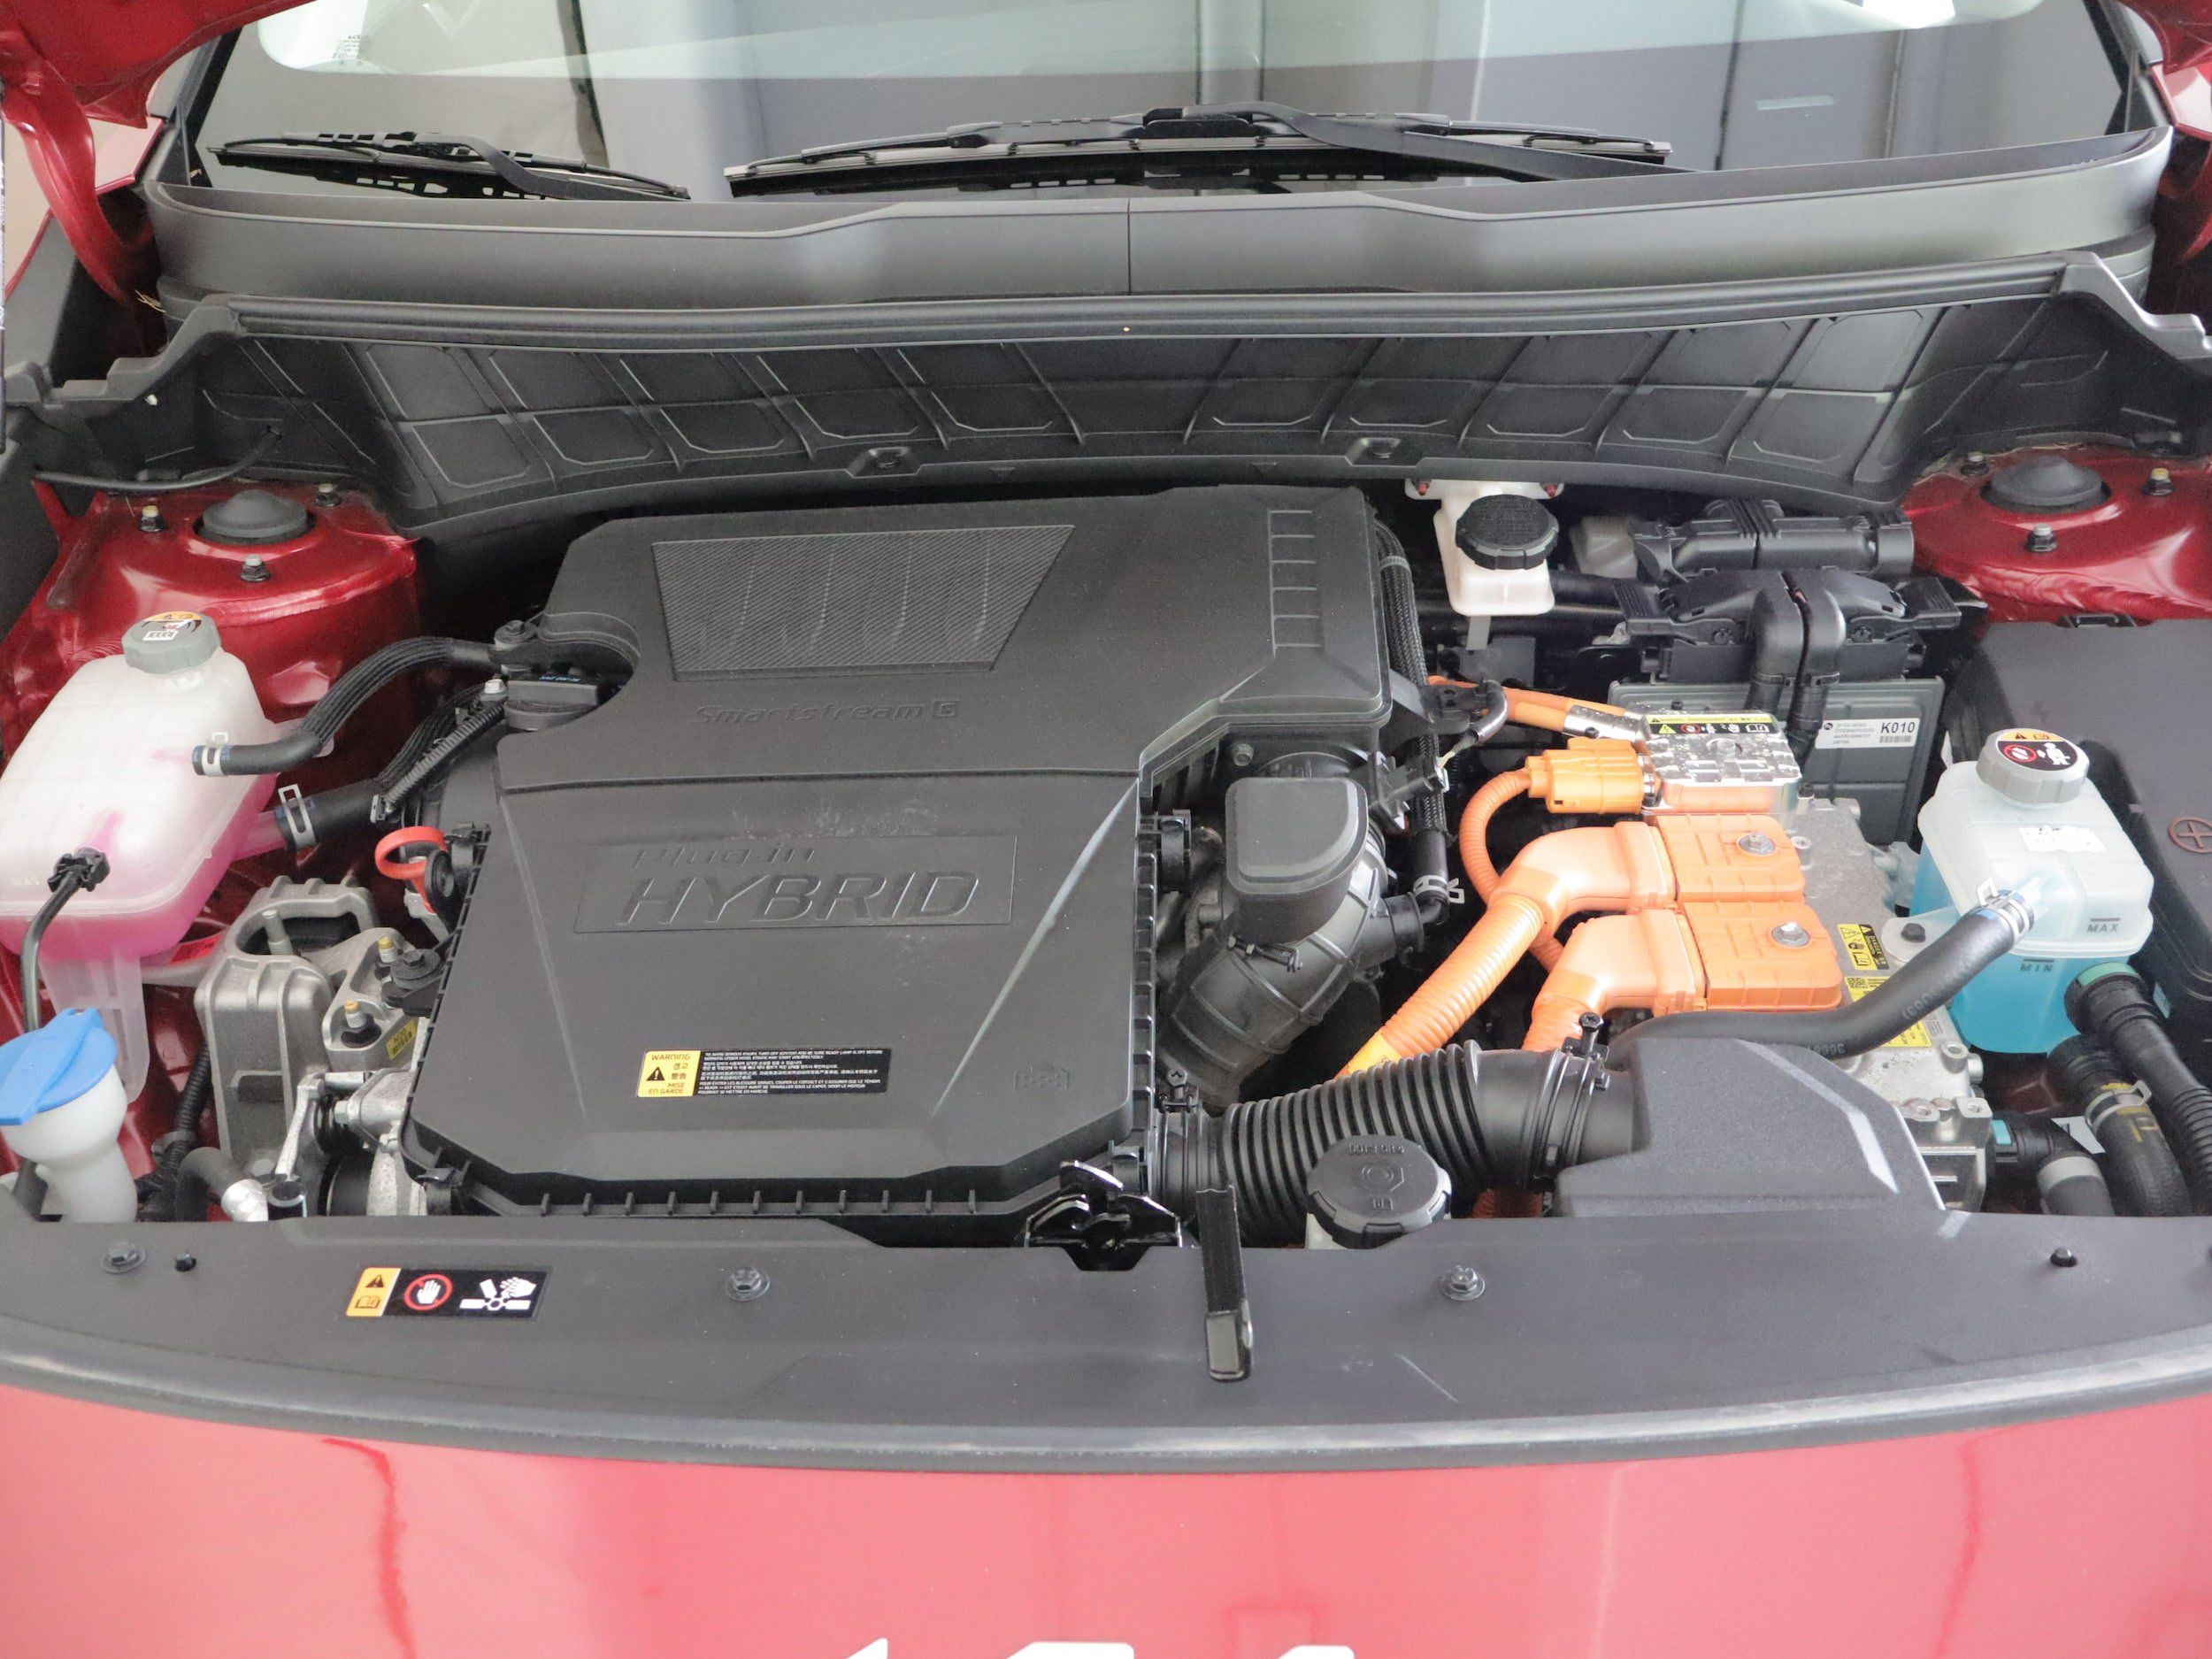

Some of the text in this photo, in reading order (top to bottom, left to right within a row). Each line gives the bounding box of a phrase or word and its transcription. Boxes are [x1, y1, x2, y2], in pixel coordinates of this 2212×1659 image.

[696, 703, 926, 725] Smartstream
[1880, 721, 1916, 733] K010
[616, 871, 979, 926] HYBRID
[2087, 923, 2119, 933] MAX
[2020, 963, 2053, 972] MIN
